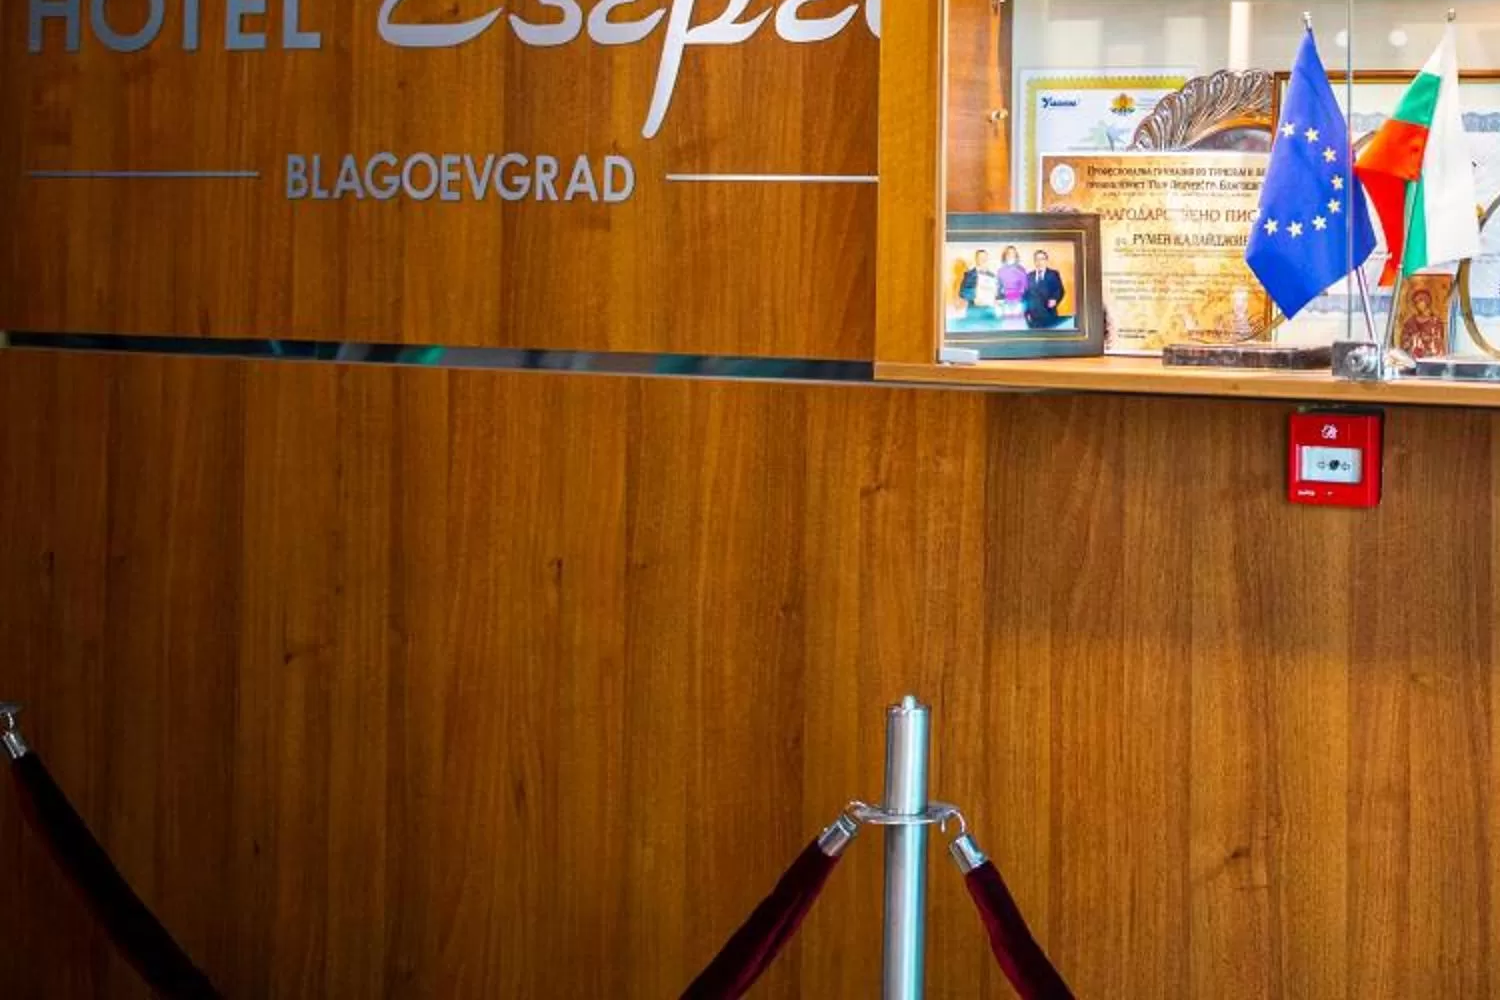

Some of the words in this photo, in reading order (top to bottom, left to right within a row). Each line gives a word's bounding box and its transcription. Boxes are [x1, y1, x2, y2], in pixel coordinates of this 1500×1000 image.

[285, 151, 635, 204] BLAGOEVGRAD
[1225, 208, 1260, 223] ПИС
[1173, 233, 1249, 247] КАЛАЙДЖИЕ
